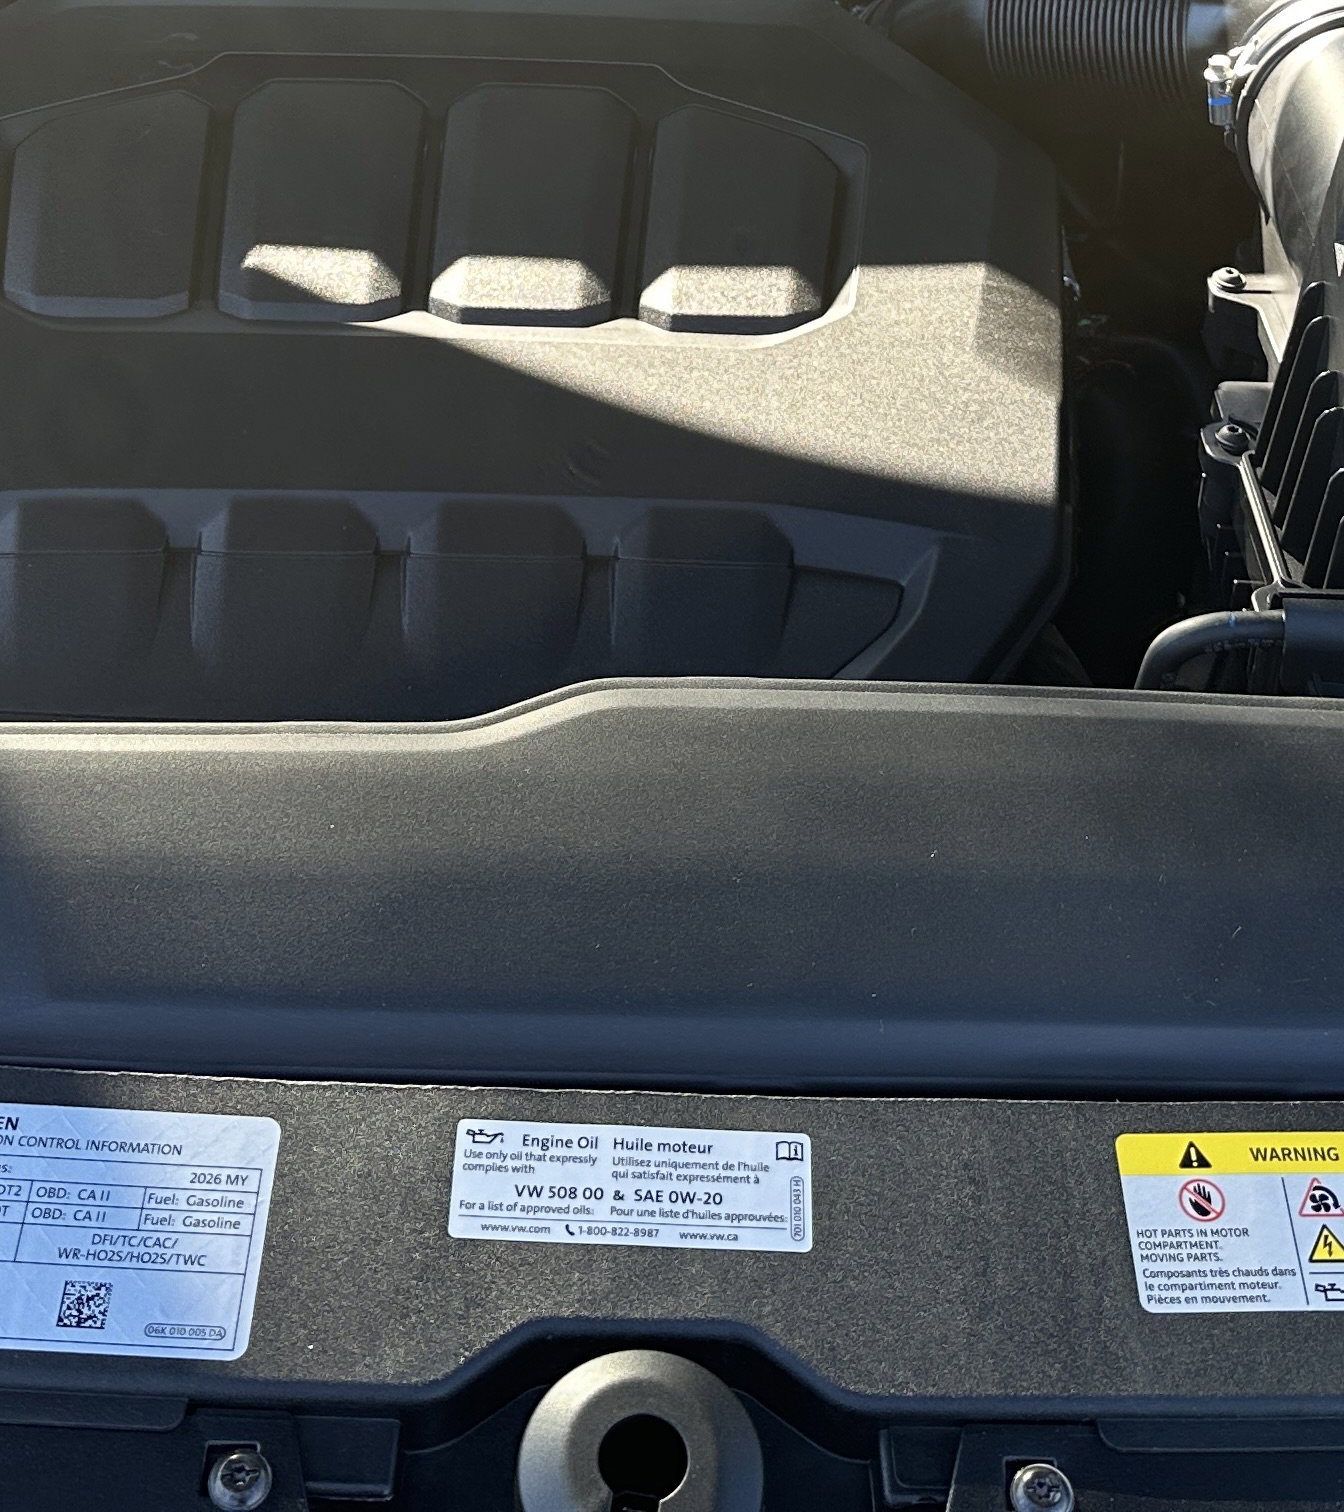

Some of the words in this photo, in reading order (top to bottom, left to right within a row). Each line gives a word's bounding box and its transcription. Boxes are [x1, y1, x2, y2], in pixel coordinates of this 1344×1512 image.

[18, 1136, 81, 1151] CONTROL
[85, 1139, 183, 1156] INFORMATION
[522, 1134, 574, 1152] Engine
[578, 1136, 599, 1149] Oil
[613, 1138, 653, 1152] Huile
[658, 1140, 714, 1154] moteur
[464, 1149, 483, 1159] Use
[486, 1150, 508, 1162] only
[510, 1151, 522, 1160] oil
[525, 1152, 547, 1161] that
[549, 1153, 597, 1166] expressly
[1250, 1147, 1339, 1162] WARNING
[463, 1162, 508, 1174] complies
[511, 1164, 535, 1174] with
[613, 1157, 651, 1167] Utilisez
[654, 1158, 719, 1172] uniquement
[722, 1161, 735, 1171] de
[190, 1173, 222, 1185] 2026
[225, 1174, 249, 1186] MY
[612, 1170, 628, 1181] qui
[631, 1171, 673, 1181] satisfait
[676, 1172, 746, 1186] expressément
[78, 1188, 100, 1201] CA
[147, 1193, 179, 1206] Fuel:
[187, 1195, 244, 1209] Gasoline
[515, 1184, 544, 1198] VW
[548, 1186, 578, 1199] 508
[583, 1187, 604, 1200] 00
[613, 1188, 625, 1201] &
[634, 1190, 663, 1203] SAE
[669, 1191, 723, 1205] 0W-20
[459, 1200, 476, 1210] For
[488, 1201, 503, 1211] list
[506, 1202, 518, 1212] of
[520, 1203, 570, 1216] approved
[610, 1206, 634, 1217] Pour
[637, 1210, 656, 1218] une
[659, 1209, 680, 1219] liste
[73, 1210, 95, 1222] CA
[144, 1214, 175, 1227] Fuel:
[183, 1216, 241, 1230] Gasoline
[481, 1224, 551, 1234] www.vw.com
[578, 1226, 659, 1238] 1-800-822-8987
[1137, 1229, 1158, 1238] HOT
[1161, 1229, 1193, 1238] PARTS
[1197, 1229, 1207, 1237] IN
[1211, 1228, 1249, 1237] MOTOR
[92, 1233, 179, 1249] DFI/TC/CAC/
[679, 1232, 739, 1242] www.vw.ca
[1141, 1253, 1184, 1262] MOVING
[1143, 1268, 1208, 1280] Composants
[1210, 1268, 1230, 1277] très
[1232, 1267, 1269, 1277] chauds
[1272, 1267, 1296, 1276] dans
[1145, 1282, 1154, 1291] le
[1158, 1281, 1236, 1293] compartiment
[1148, 1295, 1181, 1304] Pièces
